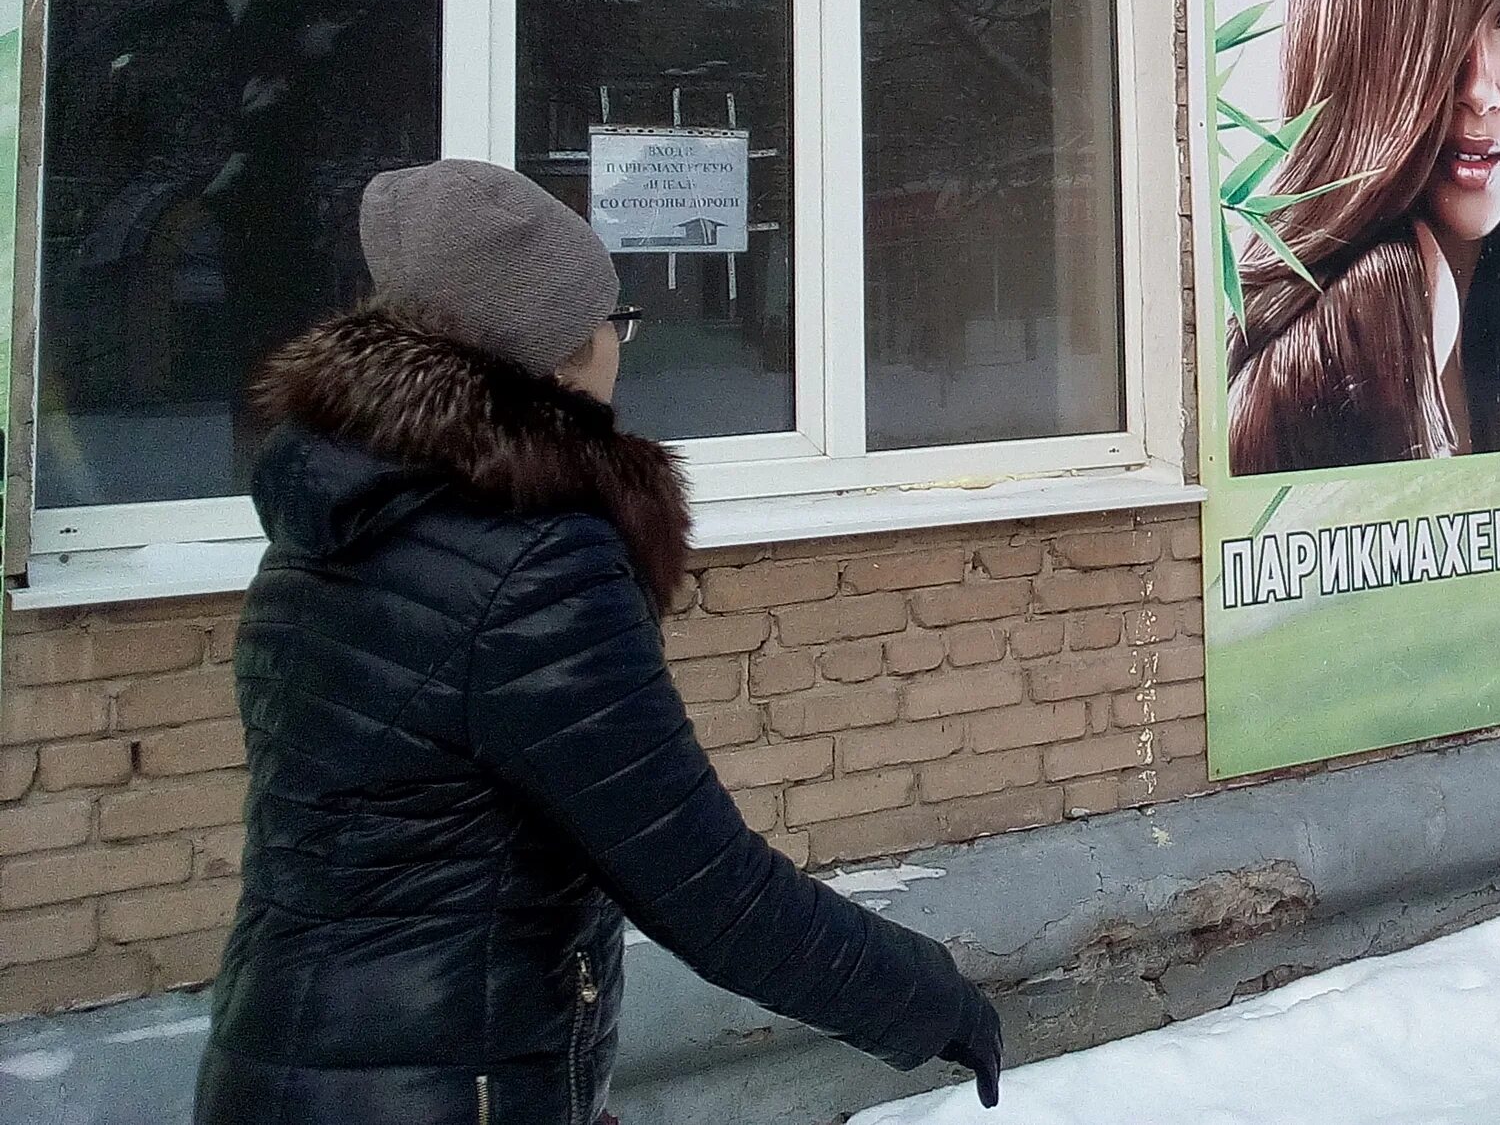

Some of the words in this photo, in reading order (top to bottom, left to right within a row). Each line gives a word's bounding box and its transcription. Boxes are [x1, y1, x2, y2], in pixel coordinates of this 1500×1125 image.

[600, 198, 619, 209] СО
[622, 197, 686, 209] СТОРОНЫ
[688, 197, 740, 208] ДОРОГИ
